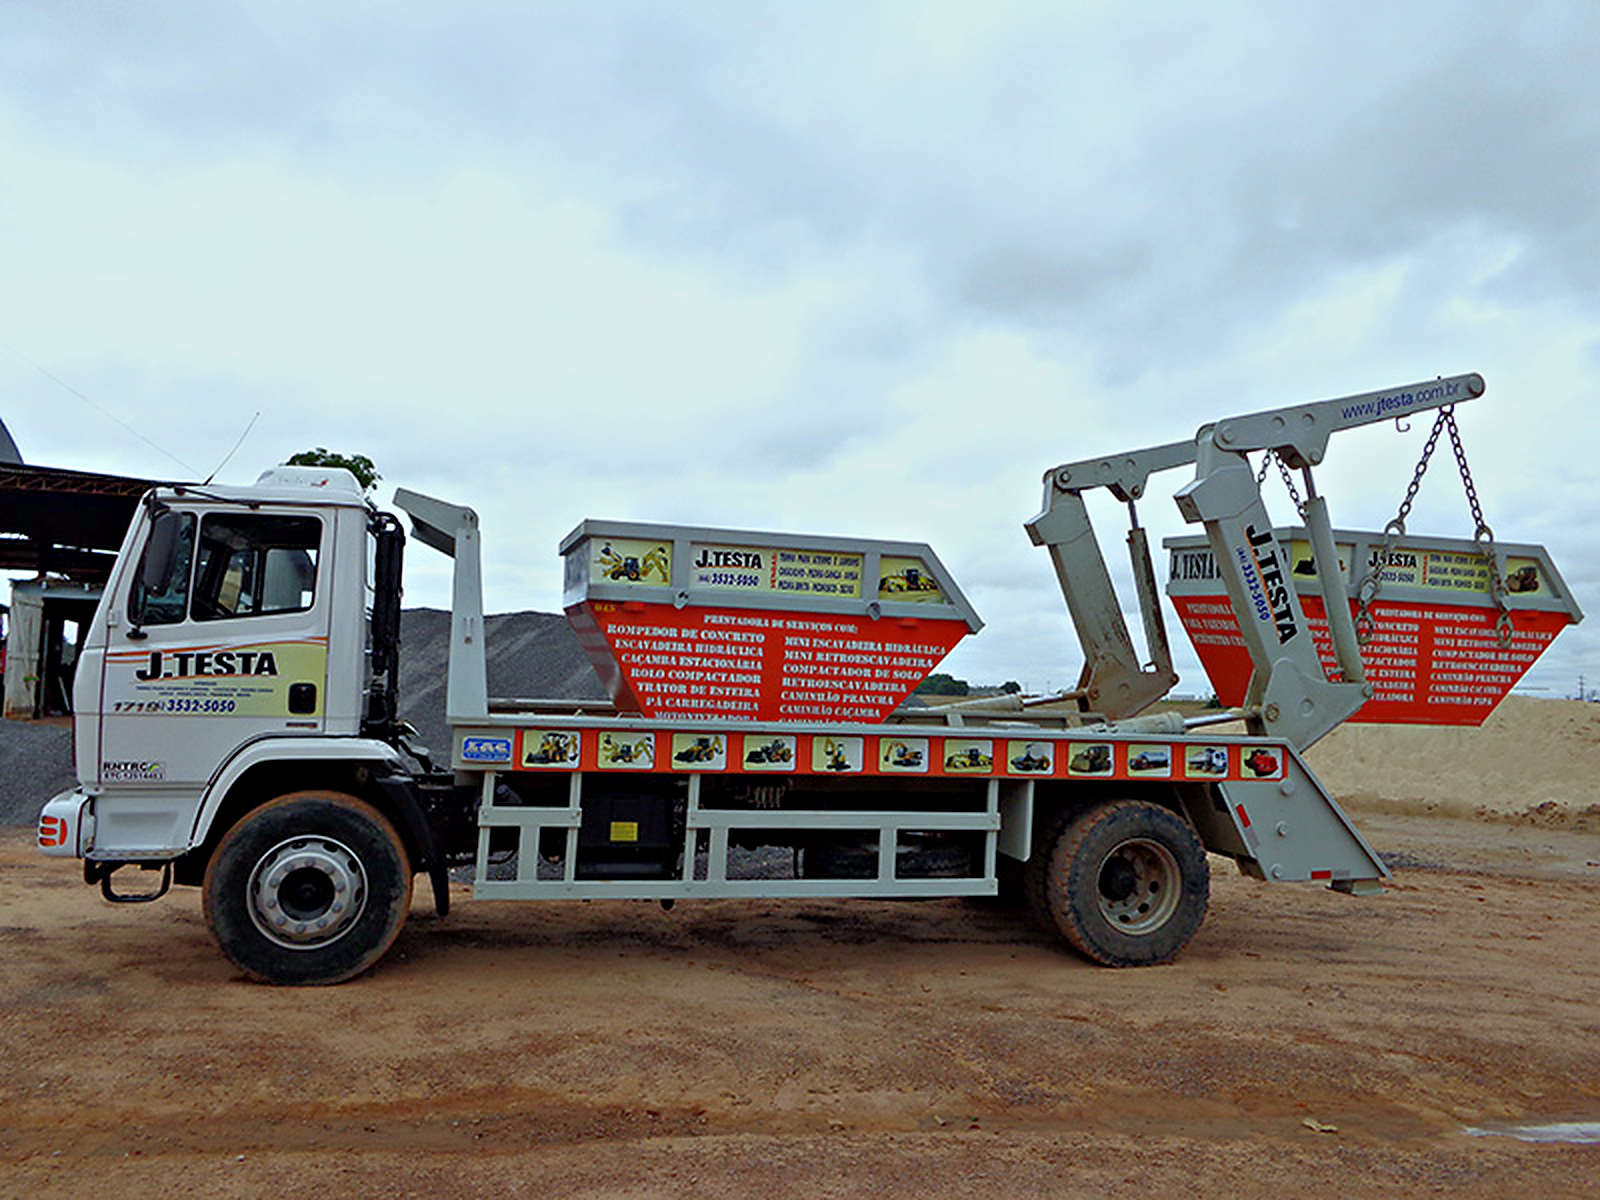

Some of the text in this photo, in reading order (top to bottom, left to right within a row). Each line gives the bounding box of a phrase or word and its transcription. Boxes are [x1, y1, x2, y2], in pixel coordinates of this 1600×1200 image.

[1341, 382, 1459, 419] www.jtesta.com.br
[695, 550, 762, 569] J.TESTA
[1246, 523, 1297, 645] J.TESTA
[704, 614, 769, 627] PRESTADORA
[772, 619, 784, 628] DE
[786, 620, 832, 633] SERVIÇOS
[607, 624, 766, 643] ROMPEDOR DE CONCRETO
[615, 639, 763, 657] ESCAVADEIRA HIDRÁULICA
[785, 636, 946, 655] MINI ESCAVADEIRA HIDRÁULICA
[135, 652, 278, 681] J.TESTA
[621, 653, 762, 670] CAÇAMBA ESTACIONÁRIA
[784, 650, 933, 668] MINI RETROESCAVADEIRA
[631, 668, 761, 684] ROLO COMPACTADOR
[783, 664, 923, 680] COMPACTADOR DE SOLO
[637, 682, 760, 697] TRATOR DE ESTEIRA
[782, 677, 907, 692] RETROESCAVADEIRA
[167, 699, 236, 713] 3532-5050
[665, 698, 759, 711] CARREGADEIRA
[781, 691, 894, 705] CAMINHÃO PRANCHA
[780, 704, 880, 718] CAMINHÃO CAÇAMBA
